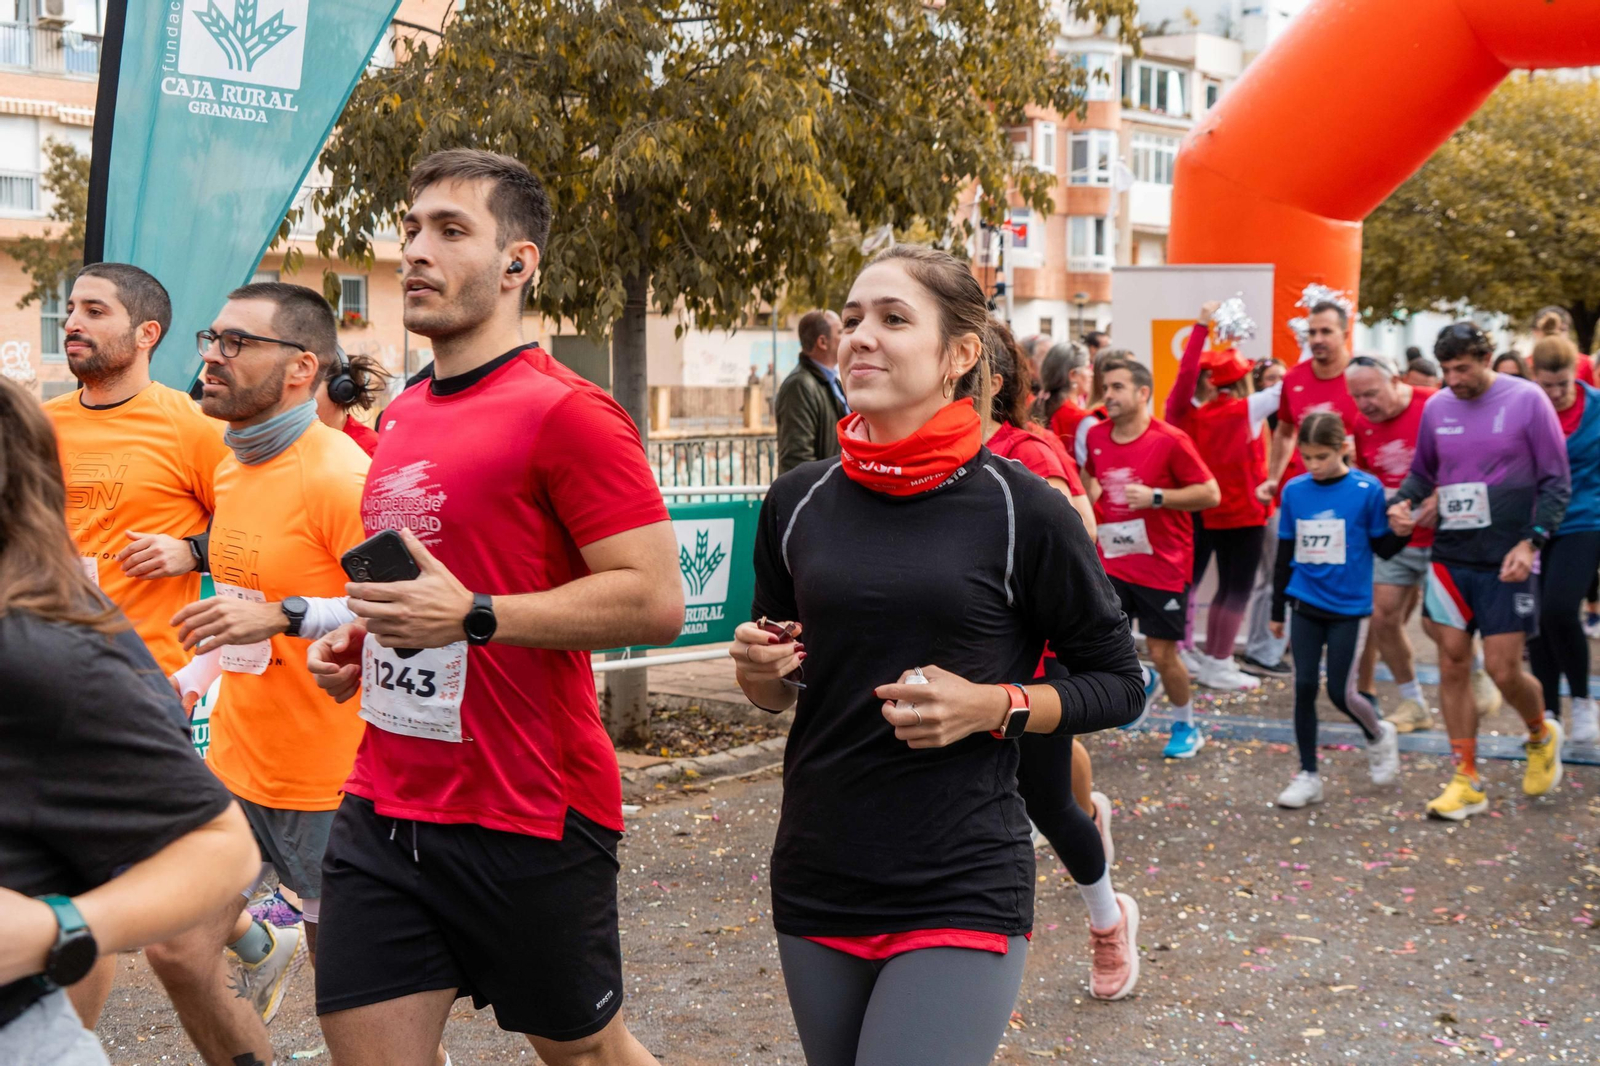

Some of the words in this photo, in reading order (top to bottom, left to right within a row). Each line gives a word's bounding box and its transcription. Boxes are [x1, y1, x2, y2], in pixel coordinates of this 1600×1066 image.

[161, 77, 216, 101] CAJA
[221, 84, 298, 112] RURAL
[188, 101, 268, 123] GRANADA
[363, 514, 442, 532] HUMANIDAD
[374, 658, 436, 698] 1243
